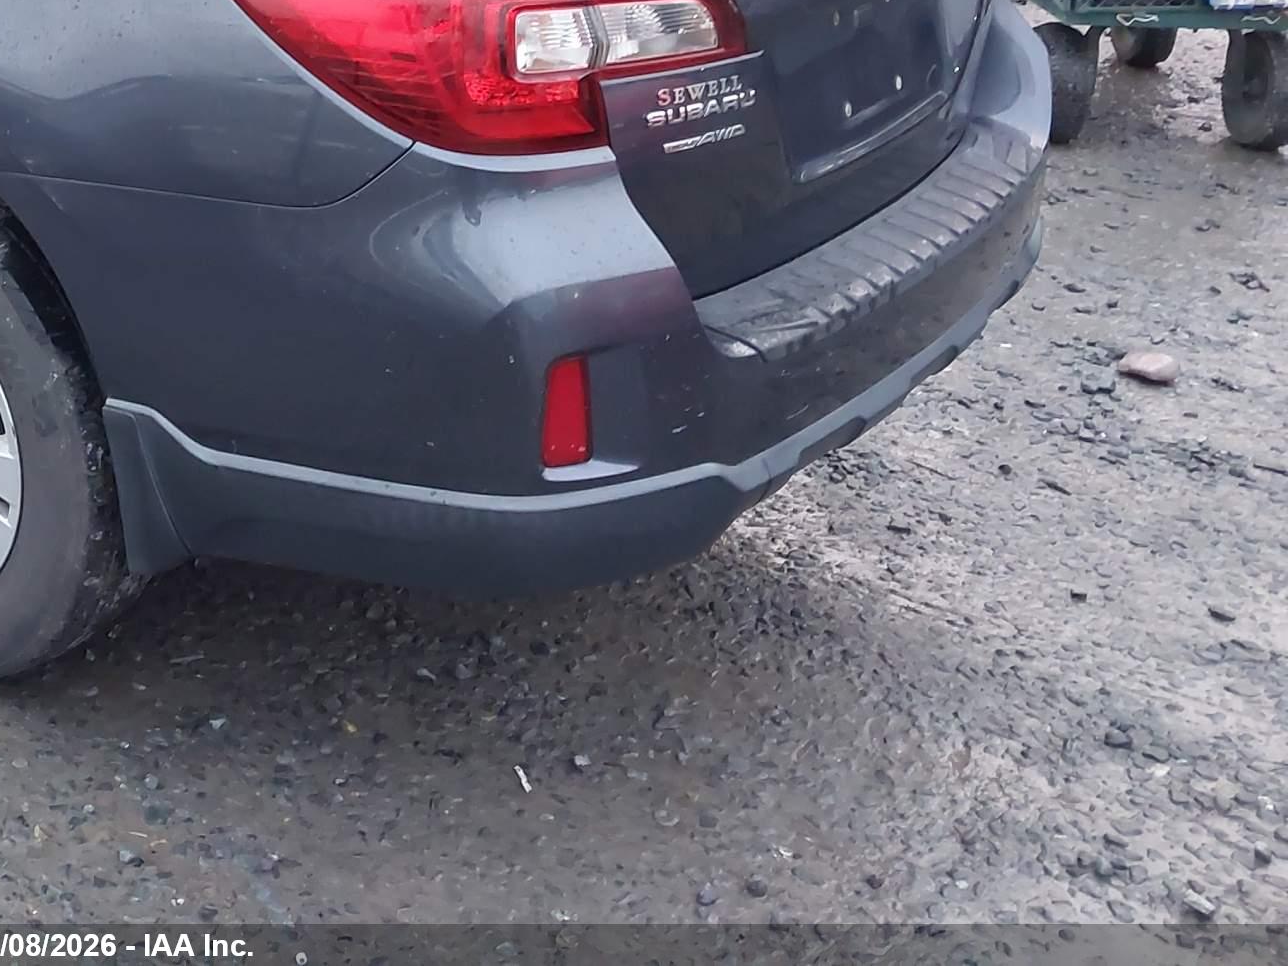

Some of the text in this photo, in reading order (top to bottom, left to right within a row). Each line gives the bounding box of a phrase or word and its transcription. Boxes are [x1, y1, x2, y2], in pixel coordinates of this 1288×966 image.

[657, 75, 742, 106] SEWELL
[646, 90, 756, 127] SUBARU
[696, 124, 745, 147] AWD
